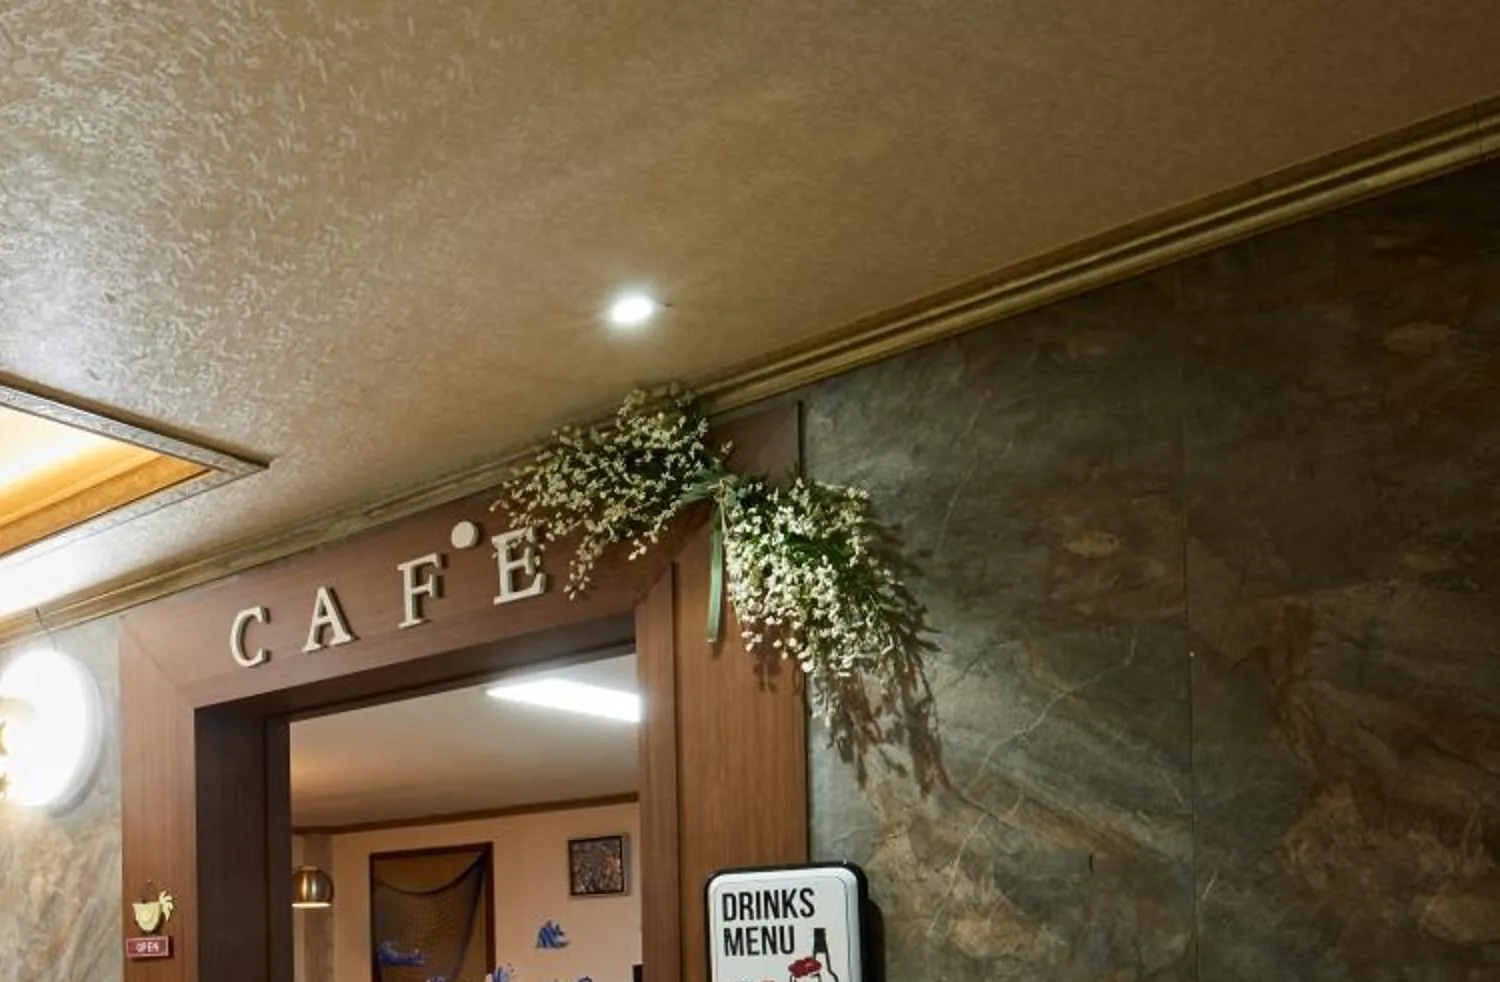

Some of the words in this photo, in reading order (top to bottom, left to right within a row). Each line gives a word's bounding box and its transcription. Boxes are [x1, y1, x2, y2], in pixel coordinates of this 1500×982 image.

[722, 887, 815, 921] DRINKS
[136, 941, 159, 953] OPEN
[723, 925, 795, 957] MENU
